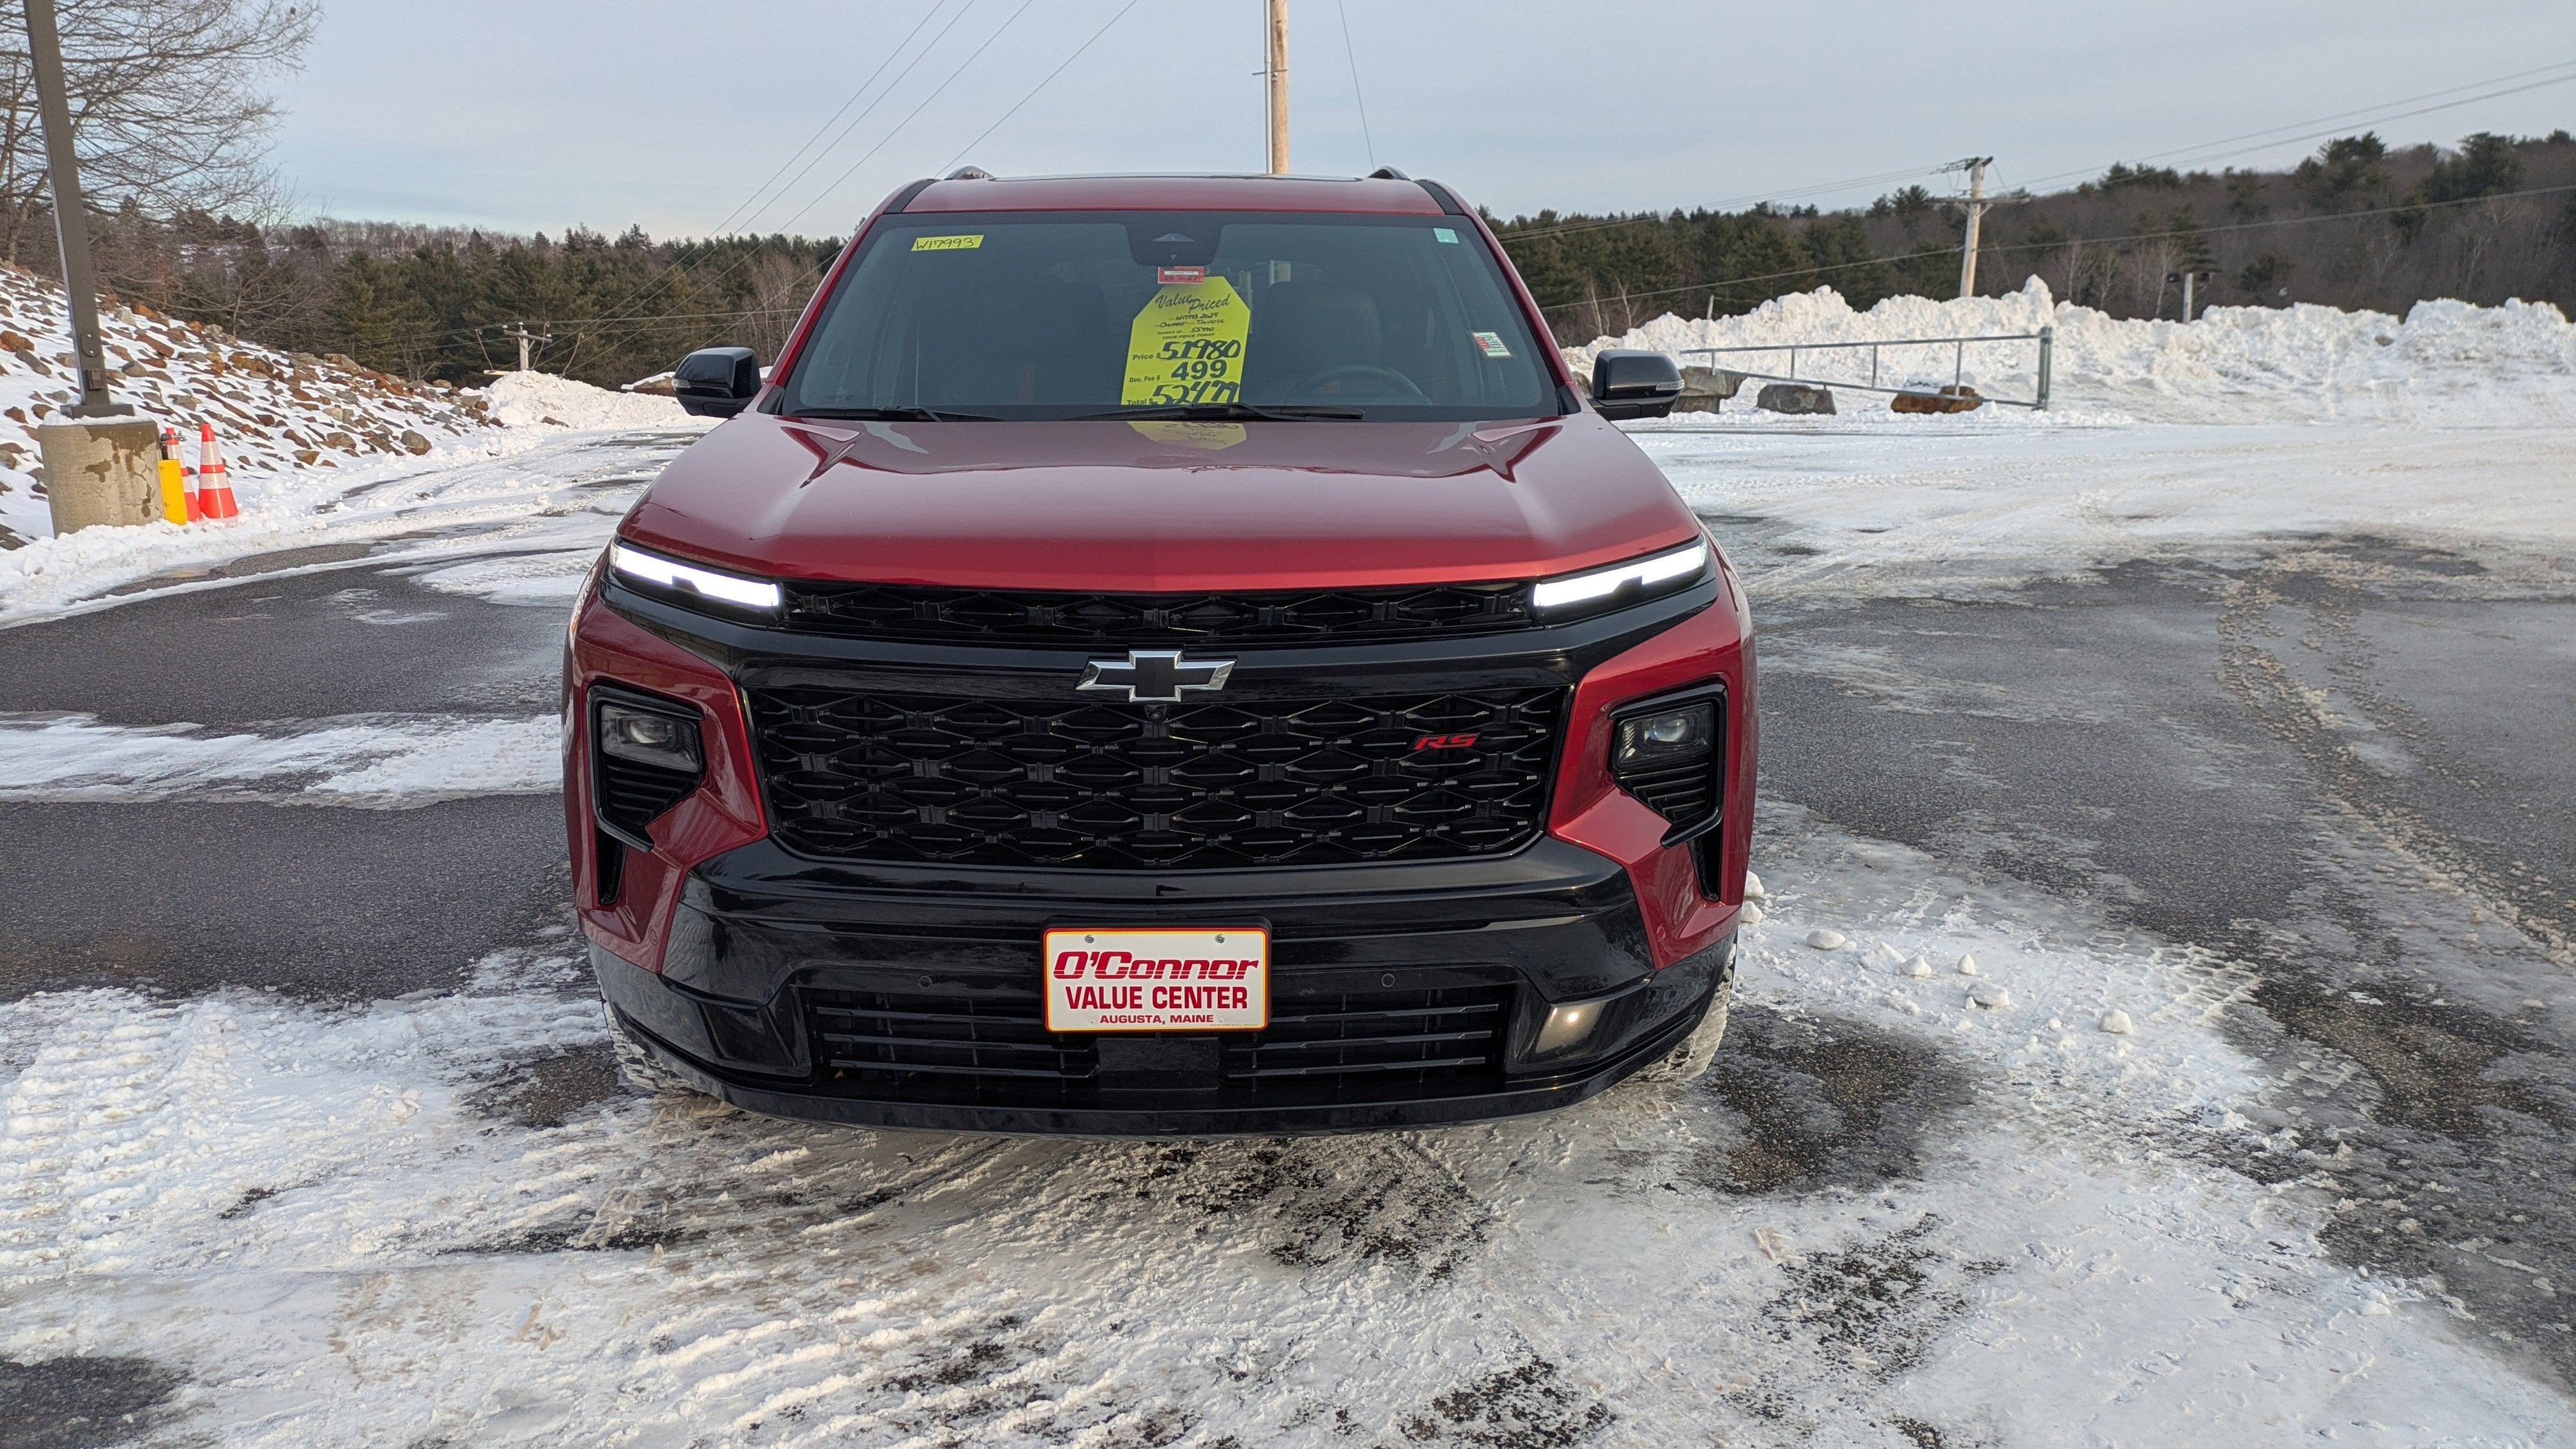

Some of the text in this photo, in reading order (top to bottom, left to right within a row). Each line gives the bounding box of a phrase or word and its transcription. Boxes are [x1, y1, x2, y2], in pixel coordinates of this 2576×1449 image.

[916, 238, 974, 249] W17993
[1155, 293, 1230, 314] Value Priced
[1162, 339, 1241, 360] 51980
[1170, 359, 1227, 380] 499
[1413, 733, 1478, 749] RS
[1053, 951, 1259, 979] O'Connor
[1065, 986, 1248, 1009] VALUE CENTER
[1100, 1015, 1214, 1025] AUGUSTA, MAINE
